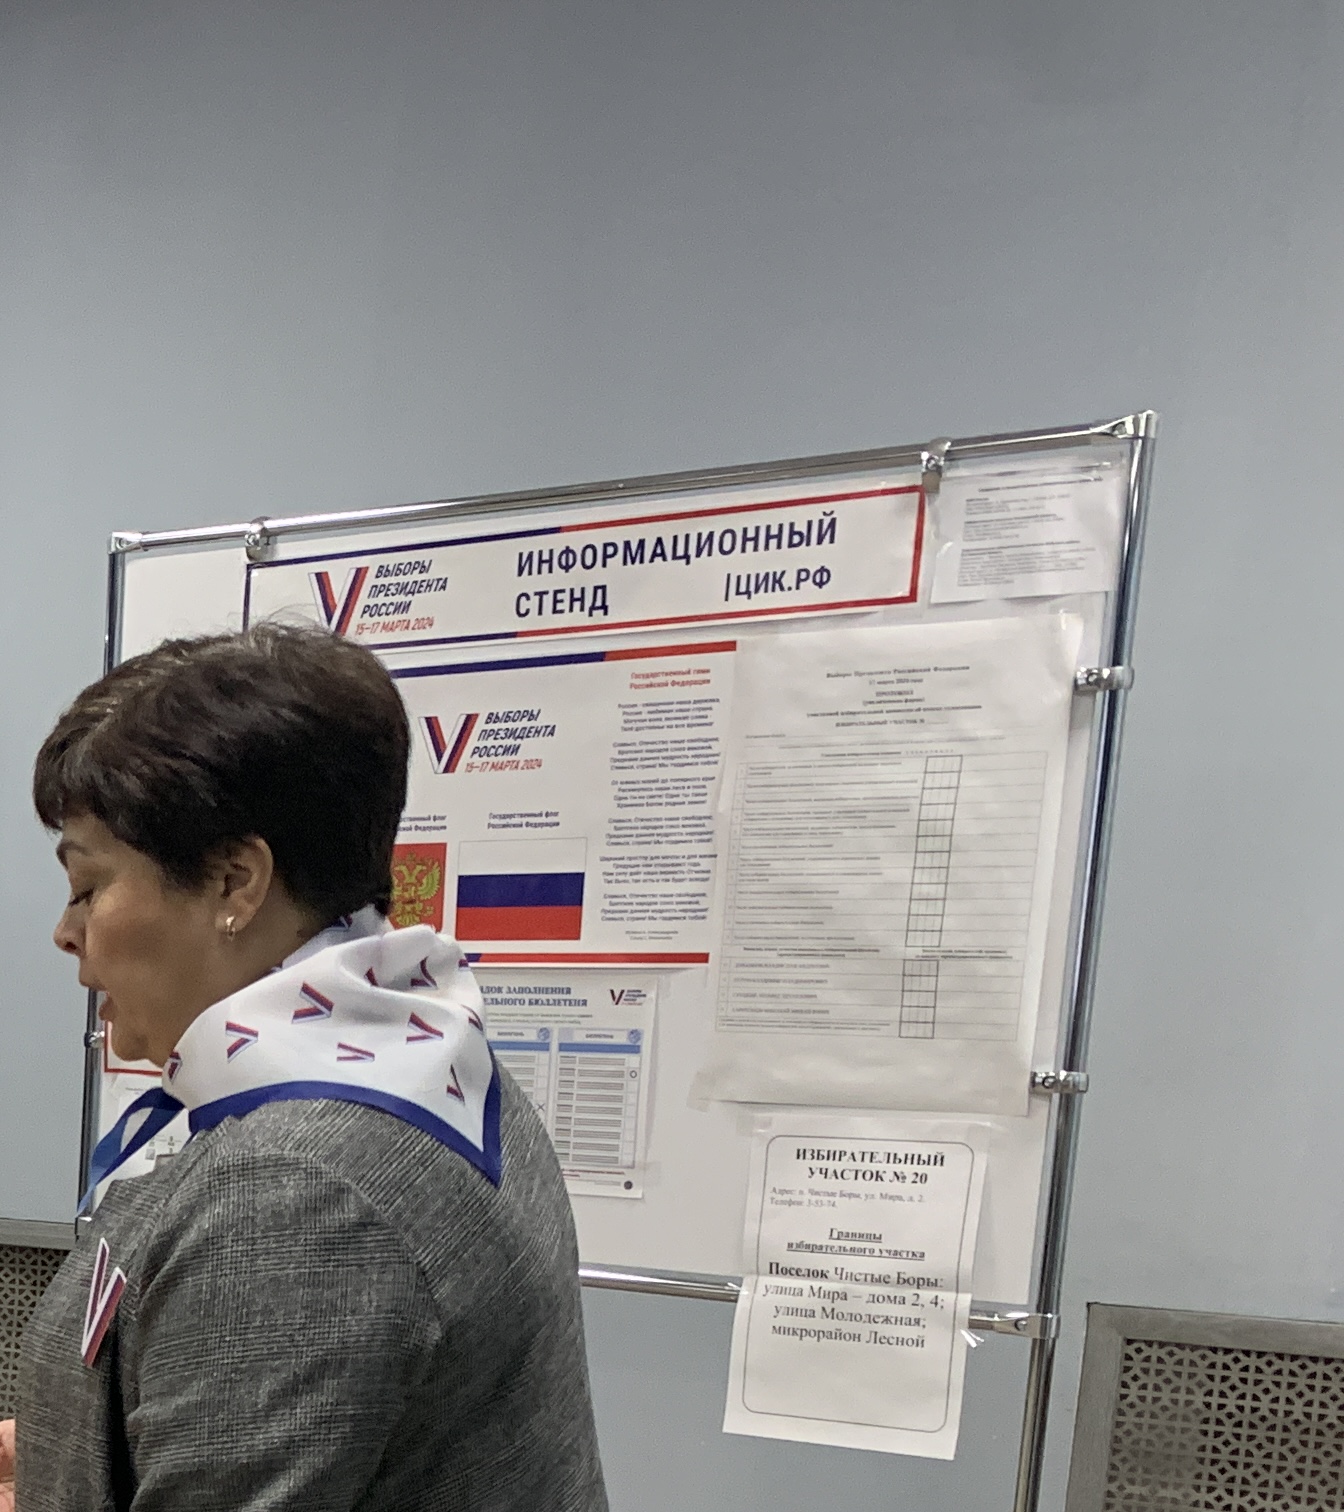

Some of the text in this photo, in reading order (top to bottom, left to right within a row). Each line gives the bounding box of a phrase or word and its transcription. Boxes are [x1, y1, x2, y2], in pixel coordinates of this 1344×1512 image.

[517, 511, 838, 577] ИНФОРМАЦИОННЫЙ
[375, 559, 433, 579] ВЫБОРЫ
[368, 577, 448, 599] ПРЕЗИДЕНТА
[361, 600, 413, 619] РОССИИ
[515, 584, 610, 618] СТЕНД
[381, 619, 410, 634] МАРТА
[412, 617, 435, 631] 2024
[484, 709, 542, 725] ВЫБОРЫ
[477, 724, 557, 742] ПРЕЗИДЕНТА
[470, 744, 521, 759] РОССИИ
[490, 759, 519, 772] МАРТА
[520, 758, 543, 771] 2024
[505, 985, 572, 995] ЗАПОЛНЕНИЯ
[527, 998, 588, 1007] БЮЛЛЕТЕНЯ
[796, 1148, 946, 1167] ИЗБИРАТЕЛЬНЫЙ
[807, 1166, 929, 1185] УЧАСТОК № 20
[828, 1228, 882, 1242] Границы
[786, 1241, 925, 1259] избирательного участка
[768, 1262, 945, 1289] Поселок Чистые Боры:
[762, 1284, 804, 1298] улица
[808, 1285, 848, 1303] Мира
[866, 1292, 906, 1305] дома
[911, 1292, 926, 1310] 2,
[929, 1293, 946, 1310] 4;
[773, 1304, 927, 1330] улица Молодежная;
[771, 1324, 926, 1349] микрорайон Лесной
